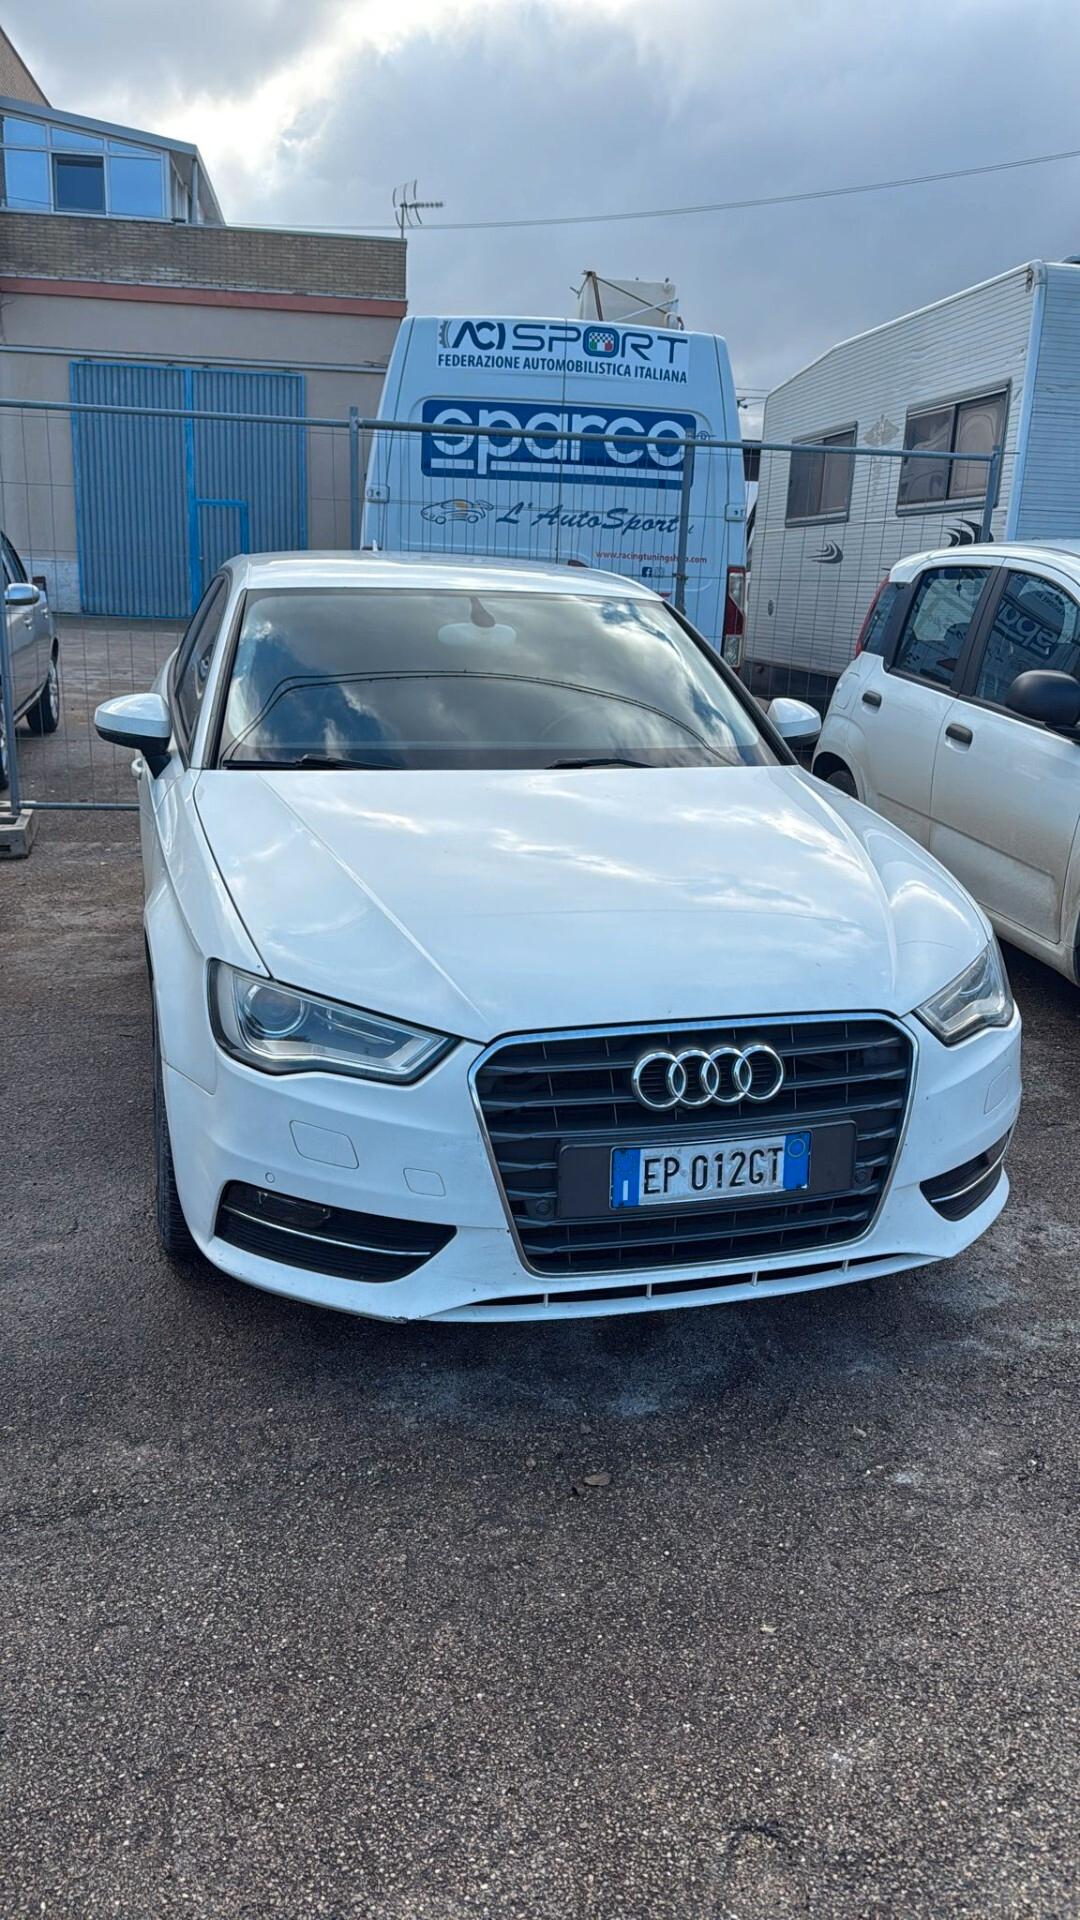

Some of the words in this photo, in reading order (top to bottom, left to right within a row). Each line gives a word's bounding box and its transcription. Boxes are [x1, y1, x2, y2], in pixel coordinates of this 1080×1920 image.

[512, 323, 688, 364] SPORT
[438, 353, 521, 369] FEDERAZIONE
[522, 357, 632, 378] AUTOMOBILISTICA
[634, 365, 687, 384] ITALIANA
[431, 408, 686, 475] sparco
[595, 550, 708, 564] www.racingtuningsh.com
[643, 1156, 680, 1195] EP
[691, 1147, 783, 1192] 012GT
